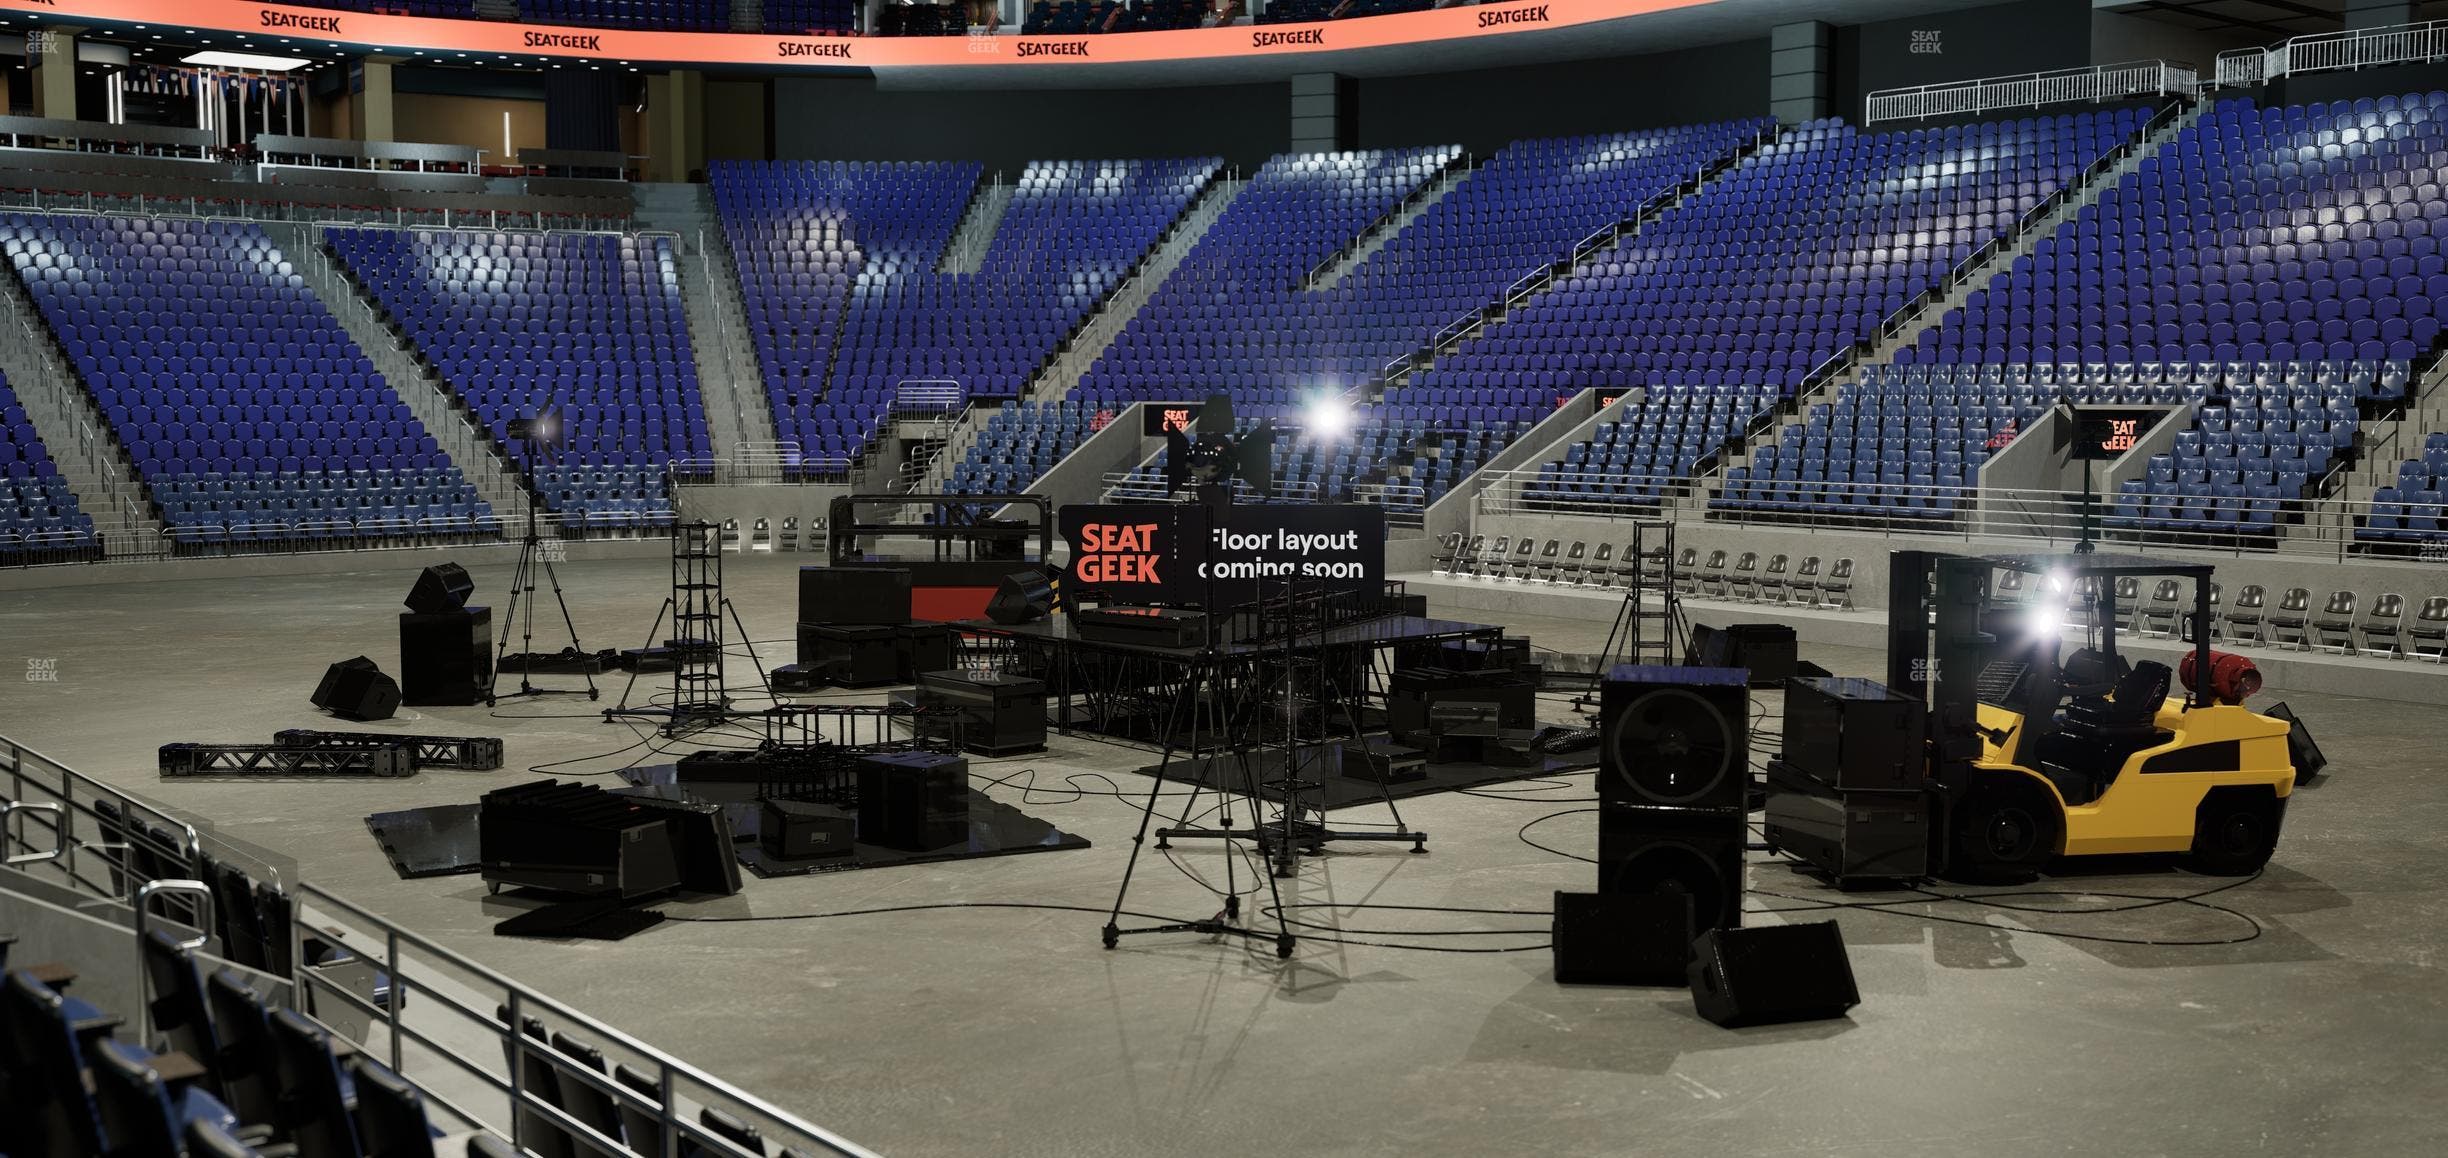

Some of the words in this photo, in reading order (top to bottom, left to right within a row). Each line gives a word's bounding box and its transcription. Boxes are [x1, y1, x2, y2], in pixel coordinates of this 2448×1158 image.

[260, 10, 341, 34] SEATGEEK
[1478, 5, 1549, 28] SEATGEEK
[524, 31, 600, 51] SEATGEEK
[1253, 28, 1323, 47] SEATGEEK
[778, 42, 851, 58] SEATGEEK
[1017, 41, 1089, 57] SEATGEEK
[1164, 410, 1188, 420] SEAT
[2107, 420, 2136, 435] EAT
[1081, 523, 1158, 552] SEAT
[1279, 528, 1358, 556] layout
[1077, 554, 1161, 584] GEEK
[1302, 561, 1364, 579] soon
